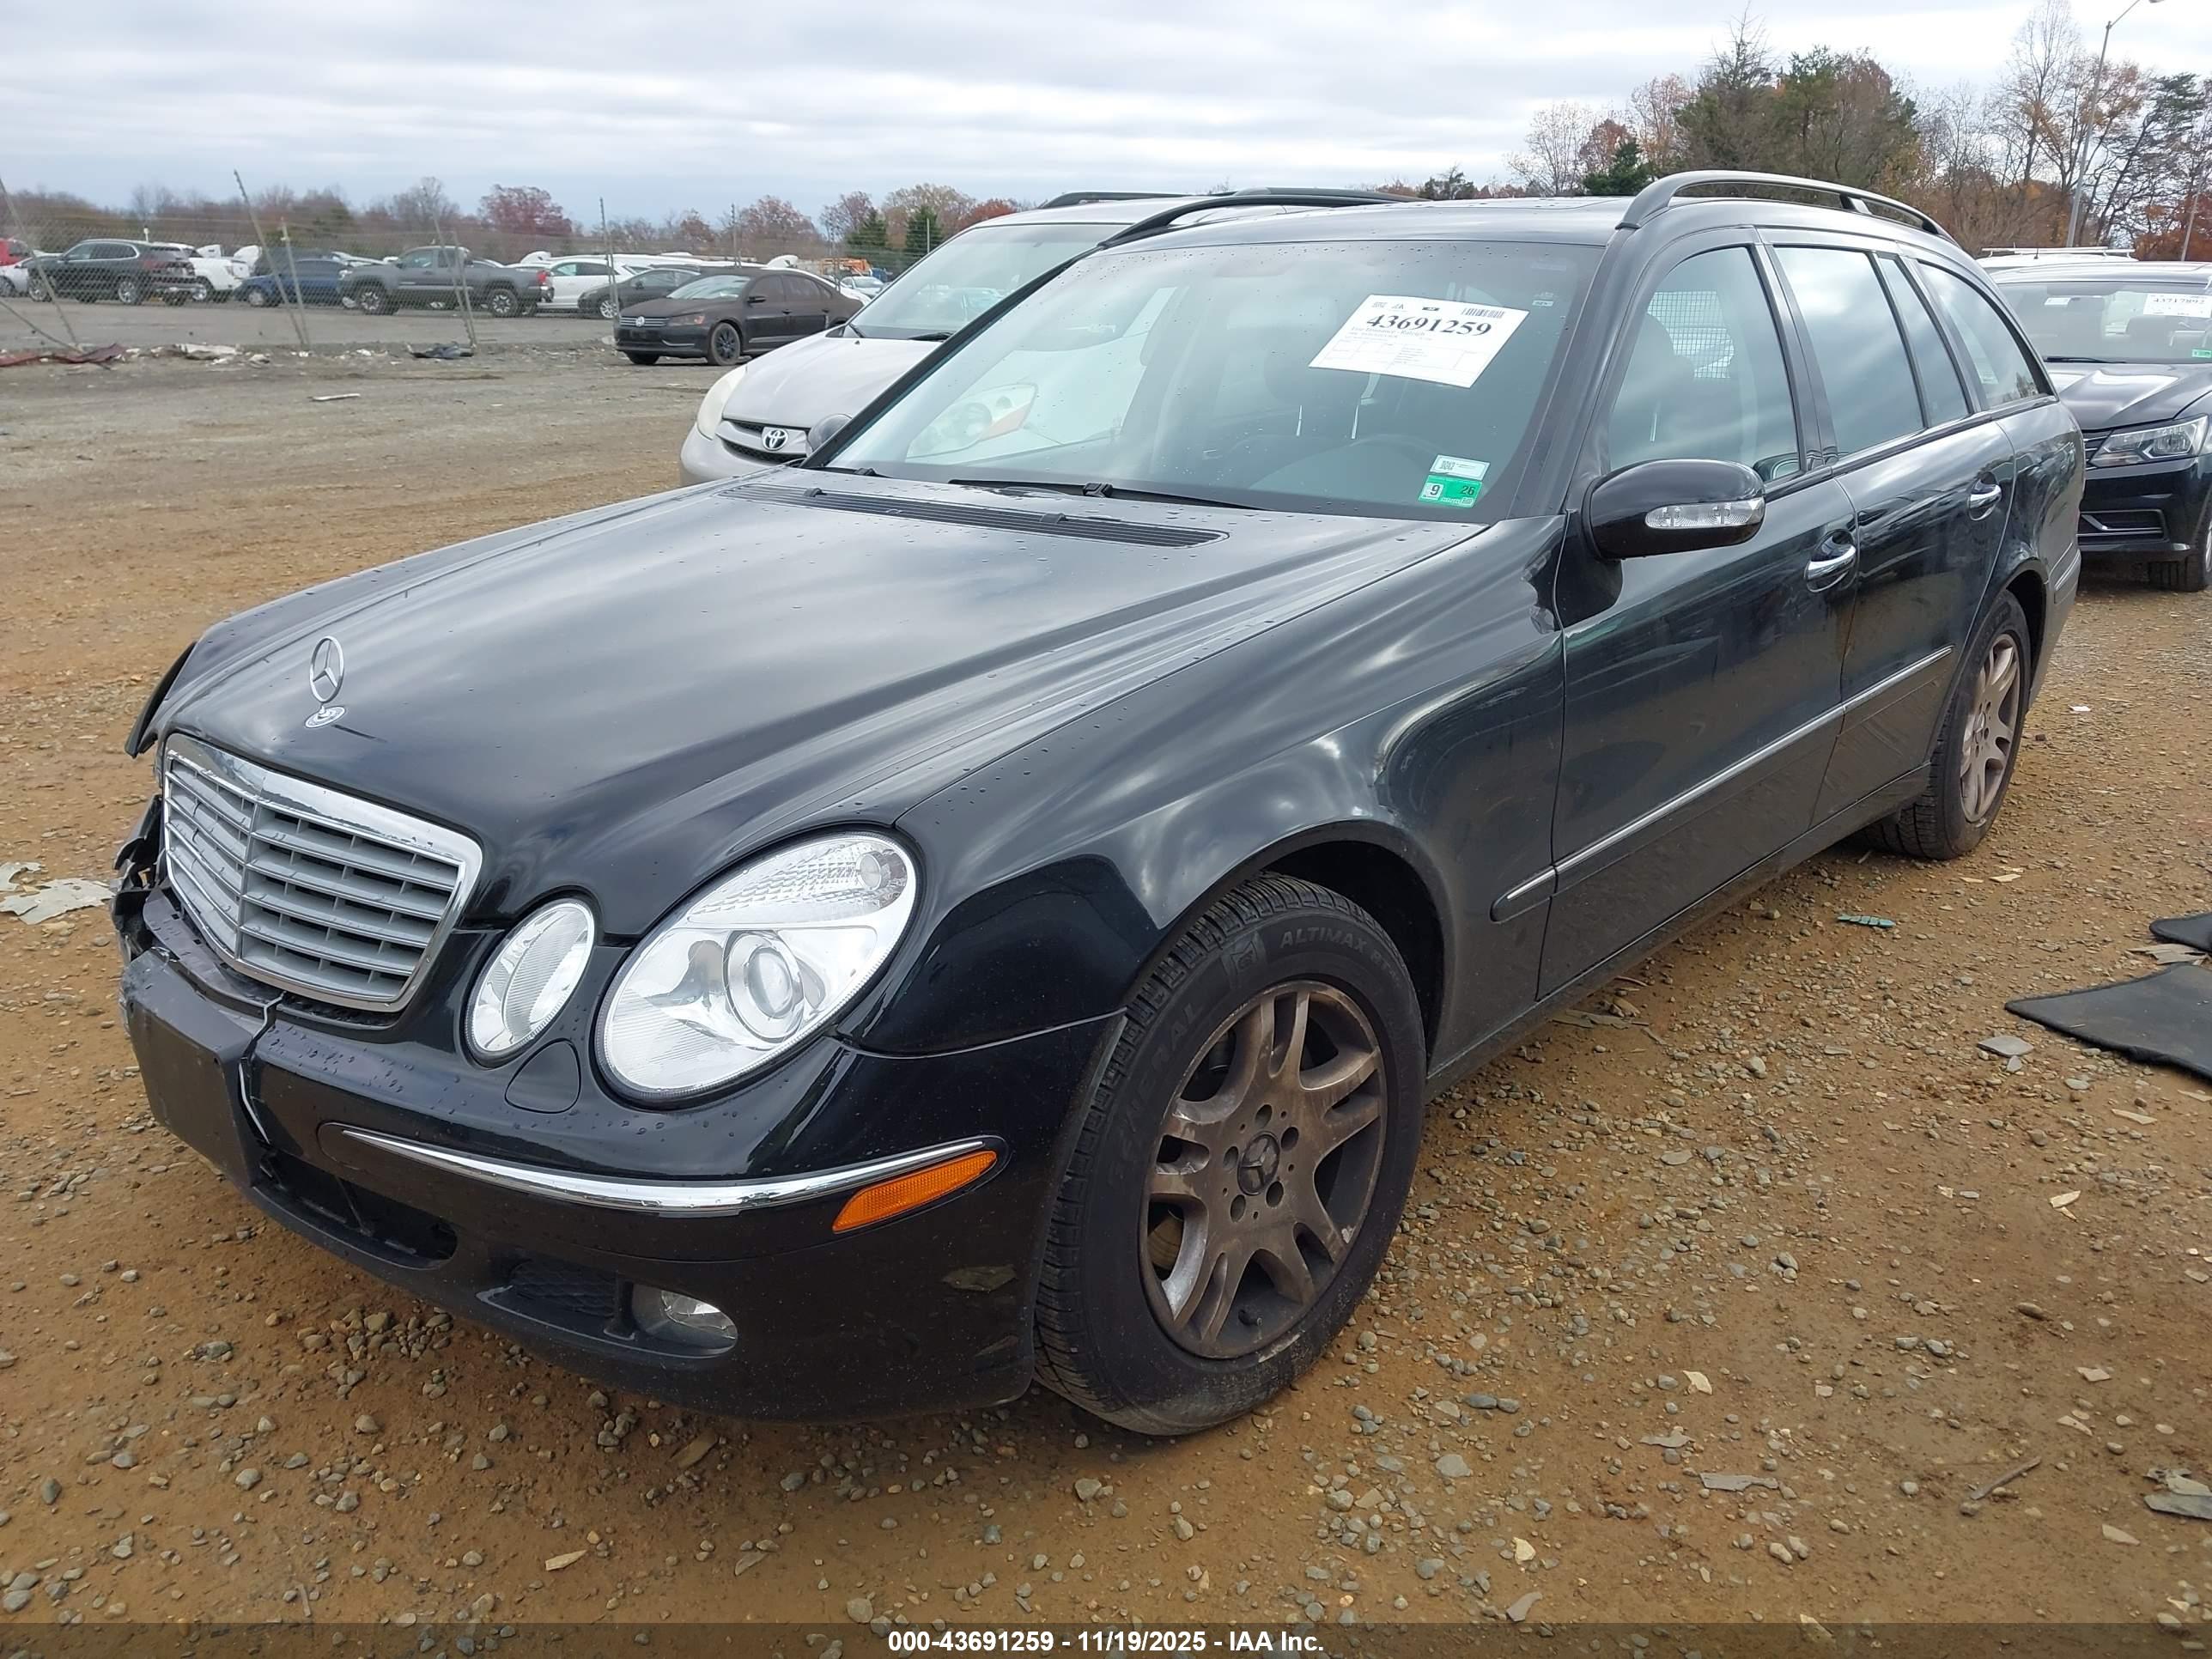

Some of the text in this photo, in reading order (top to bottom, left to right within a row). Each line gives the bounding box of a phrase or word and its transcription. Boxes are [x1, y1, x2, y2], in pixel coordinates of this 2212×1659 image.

[1366, 314, 1492, 336] 43691259
[1430, 484, 1440, 495] 9
[1460, 485, 1475, 495] 26
[1279, 927, 1368, 954] ALTIMAX
